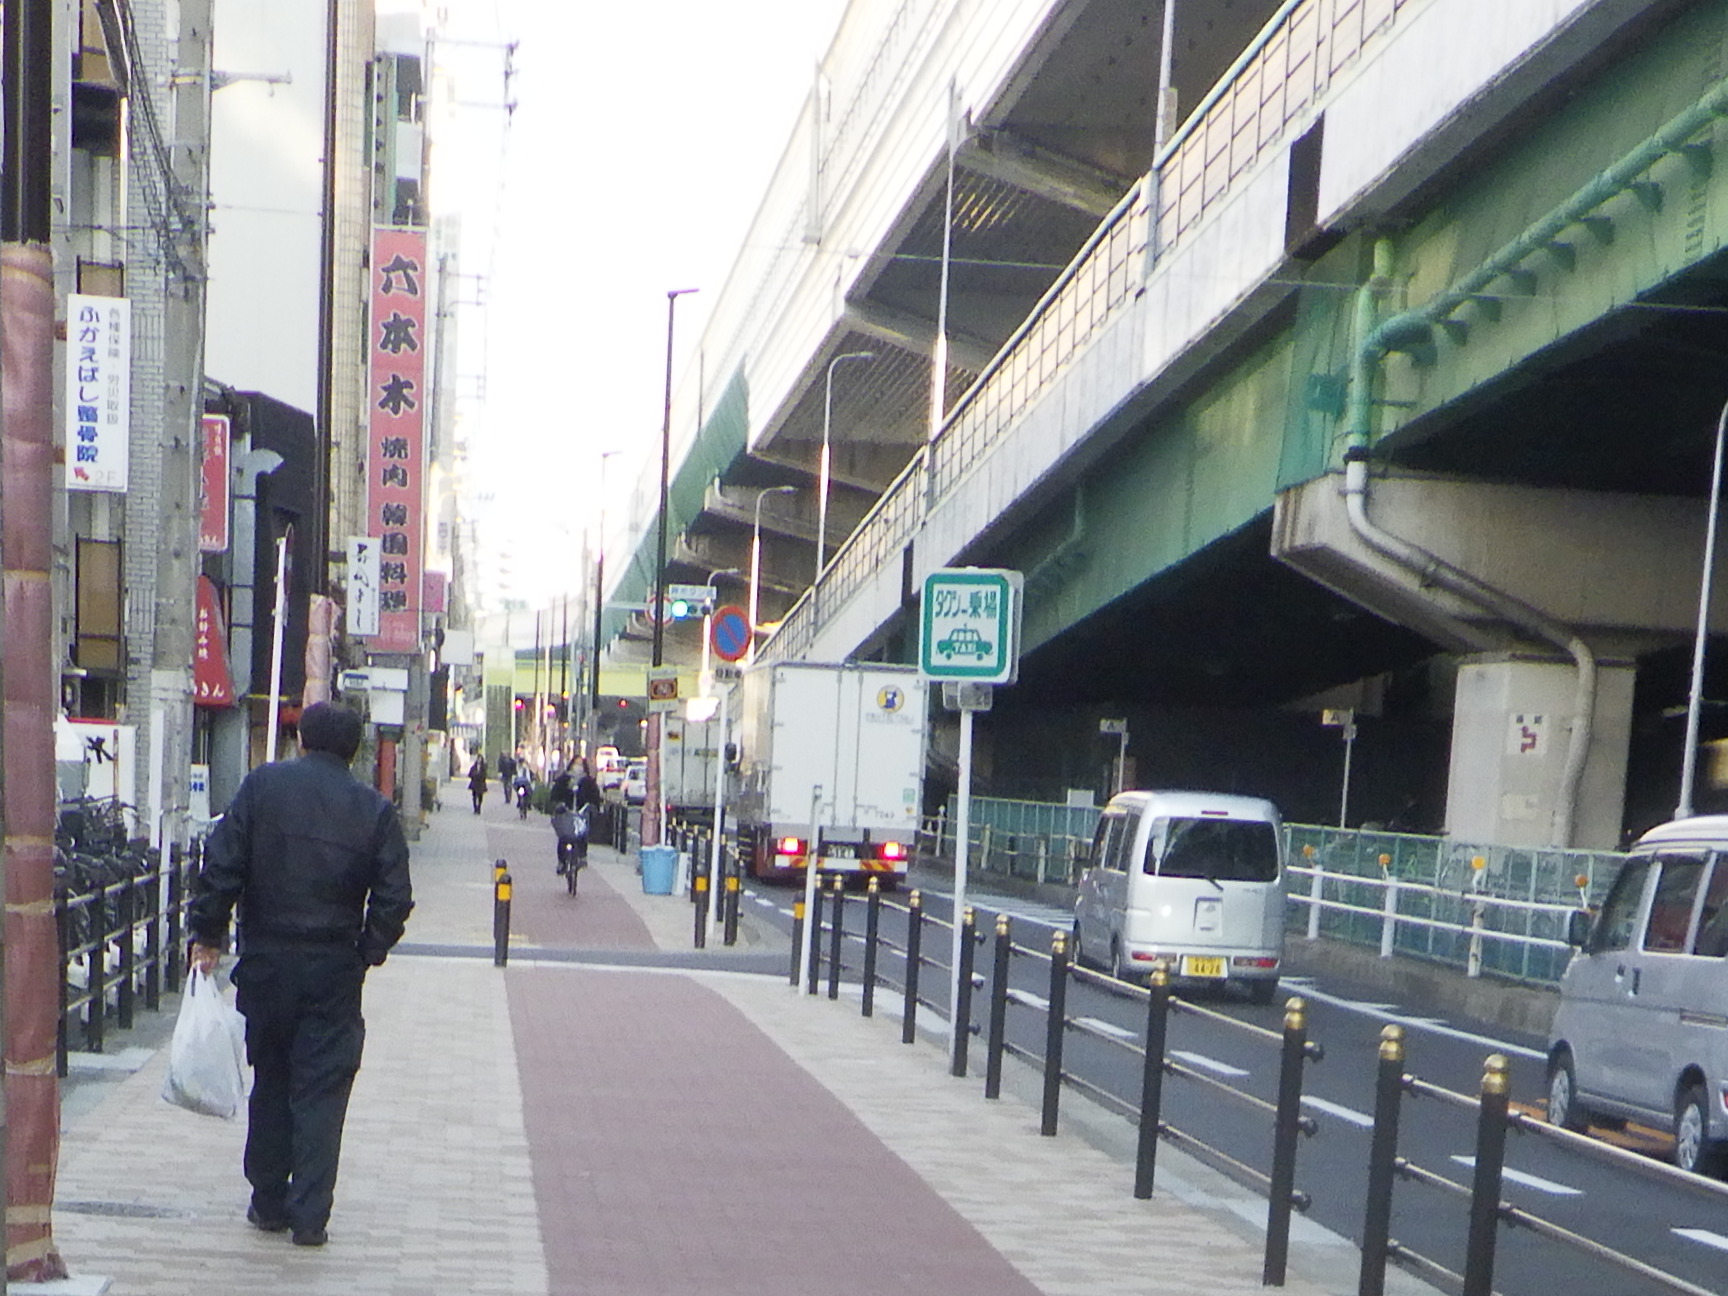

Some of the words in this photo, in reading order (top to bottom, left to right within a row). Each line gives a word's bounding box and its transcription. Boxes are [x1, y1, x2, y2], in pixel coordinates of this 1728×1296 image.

[379, 254, 418, 416] 六本木
[381, 436, 409, 488] 焼肉
[934, 590, 997, 619] タクシー乗場
